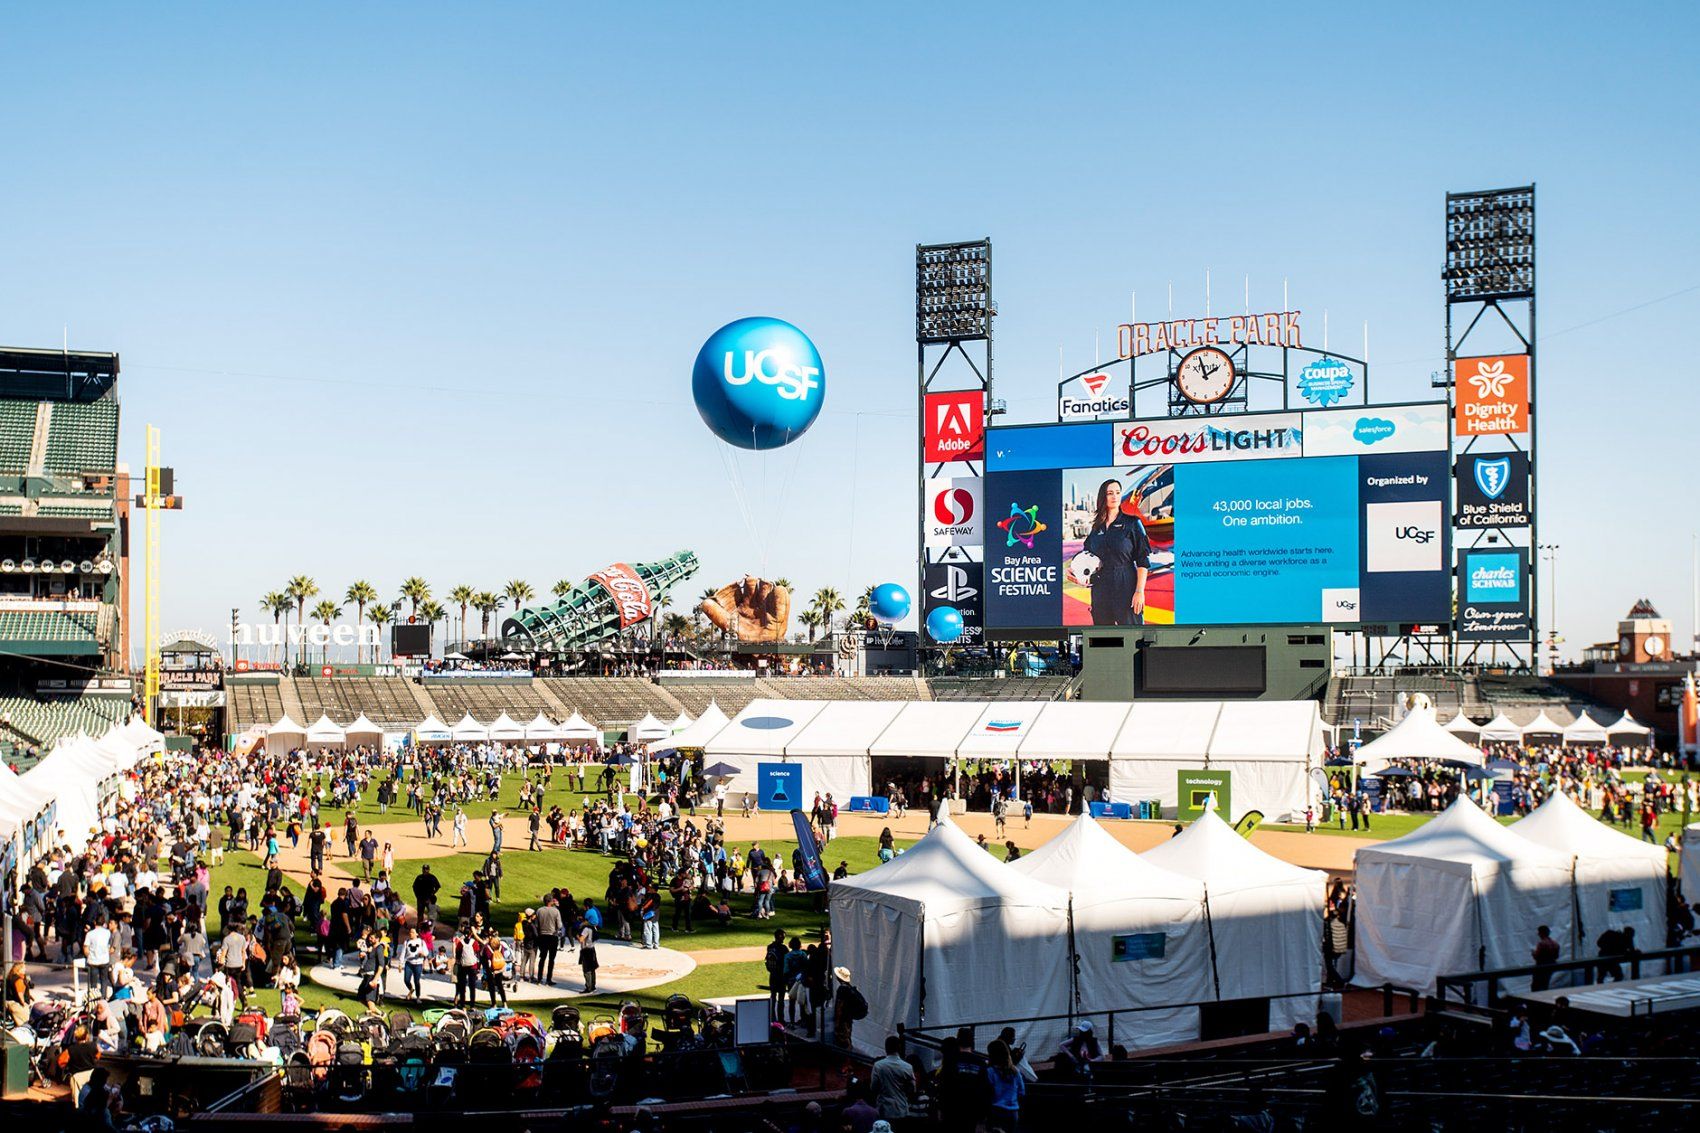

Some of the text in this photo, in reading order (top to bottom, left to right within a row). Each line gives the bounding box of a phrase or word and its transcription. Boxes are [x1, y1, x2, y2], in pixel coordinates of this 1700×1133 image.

[1117, 310, 1303, 361] ORACLE PARK
[724, 349, 819, 401] UCSF
[1304, 366, 1350, 384] coupa
[1062, 398, 1129, 415] Fanatics
[1464, 402, 1518, 419] Dignity
[1358, 426, 1392, 435] salesforce
[937, 437, 971, 451] Adobe
[1121, 425, 1287, 457] Coors LIGHT
[1367, 475, 1429, 487] Organized by
[1212, 498, 1313, 512] 43,000 local jobs.
[1463, 502, 1523, 514] Blue Shield
[1222, 513, 1303, 527] One ambition.
[1459, 514, 1527, 525] of California
[1395, 526, 1435, 544] UCSF
[1180, 550, 1221, 559] Advancing
[1222, 549, 1247, 557] health
[1248, 548, 1288, 556] worldwide
[1289, 547, 1313, 555] starts
[1004, 556, 1042, 566] Bay Area
[1181, 560, 1203, 568] We're
[1204, 559, 1229, 568] uniting
[1238, 558, 1267, 566] diverse
[1268, 557, 1308, 565] workforce
[991, 566, 1057, 583] SCIENCE
[1181, 570, 1212, 578] regional
[1212, 569, 1251, 577] economic
[1471, 566, 1514, 580] charles
[999, 584, 1051, 596] FESTIVAL
[1471, 579, 1515, 589] SCHWAB
[1336, 600, 1356, 610] UCSF
[1463, 607, 1525, 624] Own your
[1463, 622, 1526, 632] tomorrow
[227, 623, 382, 646] nuveen
[195, 672, 220, 685] PARK
[177, 695, 208, 706] EXIT
